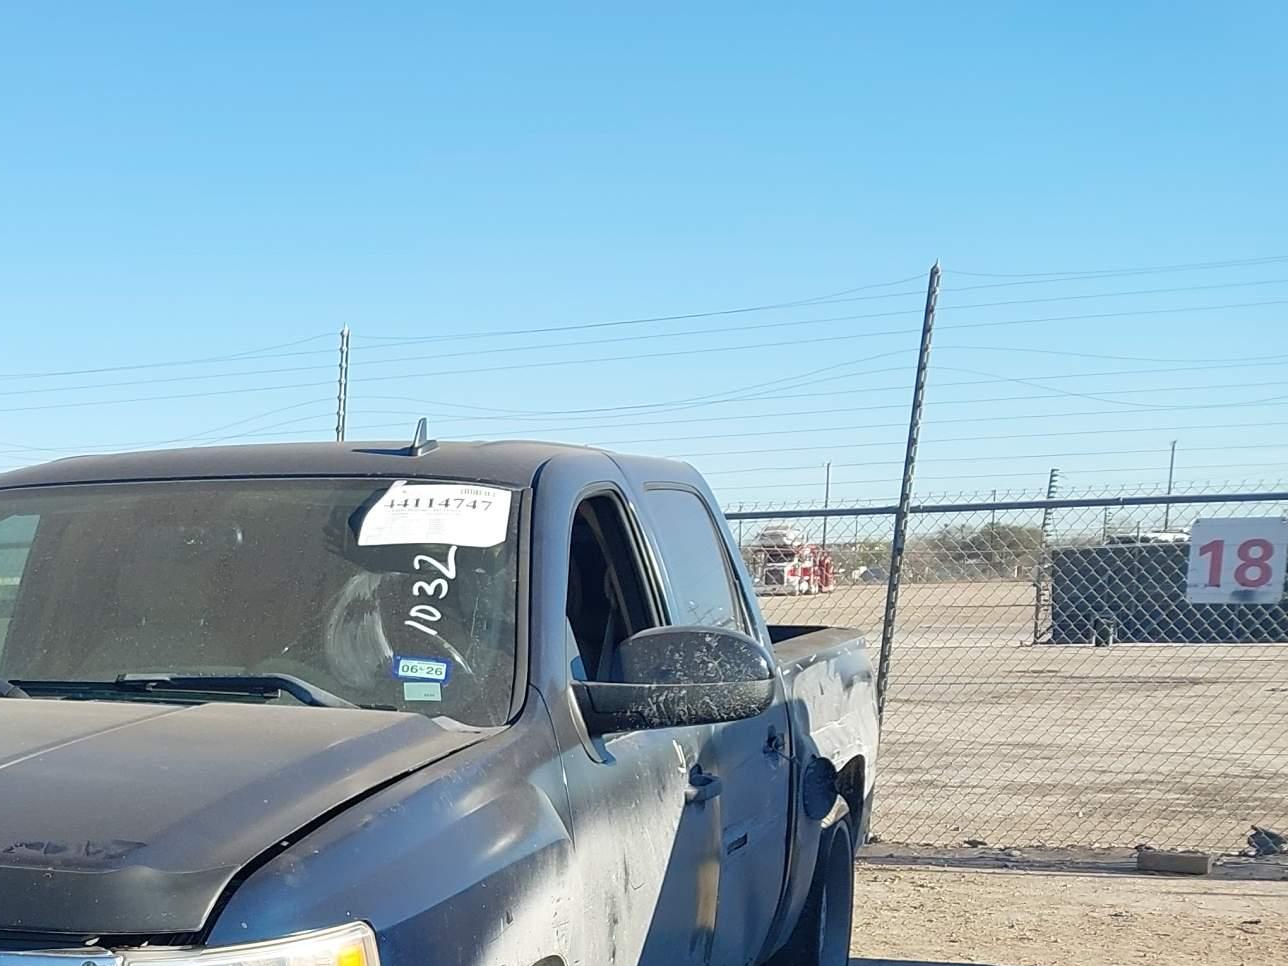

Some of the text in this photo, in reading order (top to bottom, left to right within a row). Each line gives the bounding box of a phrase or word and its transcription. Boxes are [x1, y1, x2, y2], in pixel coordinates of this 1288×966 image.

[384, 497, 493, 512] 44114747
[1198, 537, 1275, 589] 18
[403, 544, 458, 636] 1032
